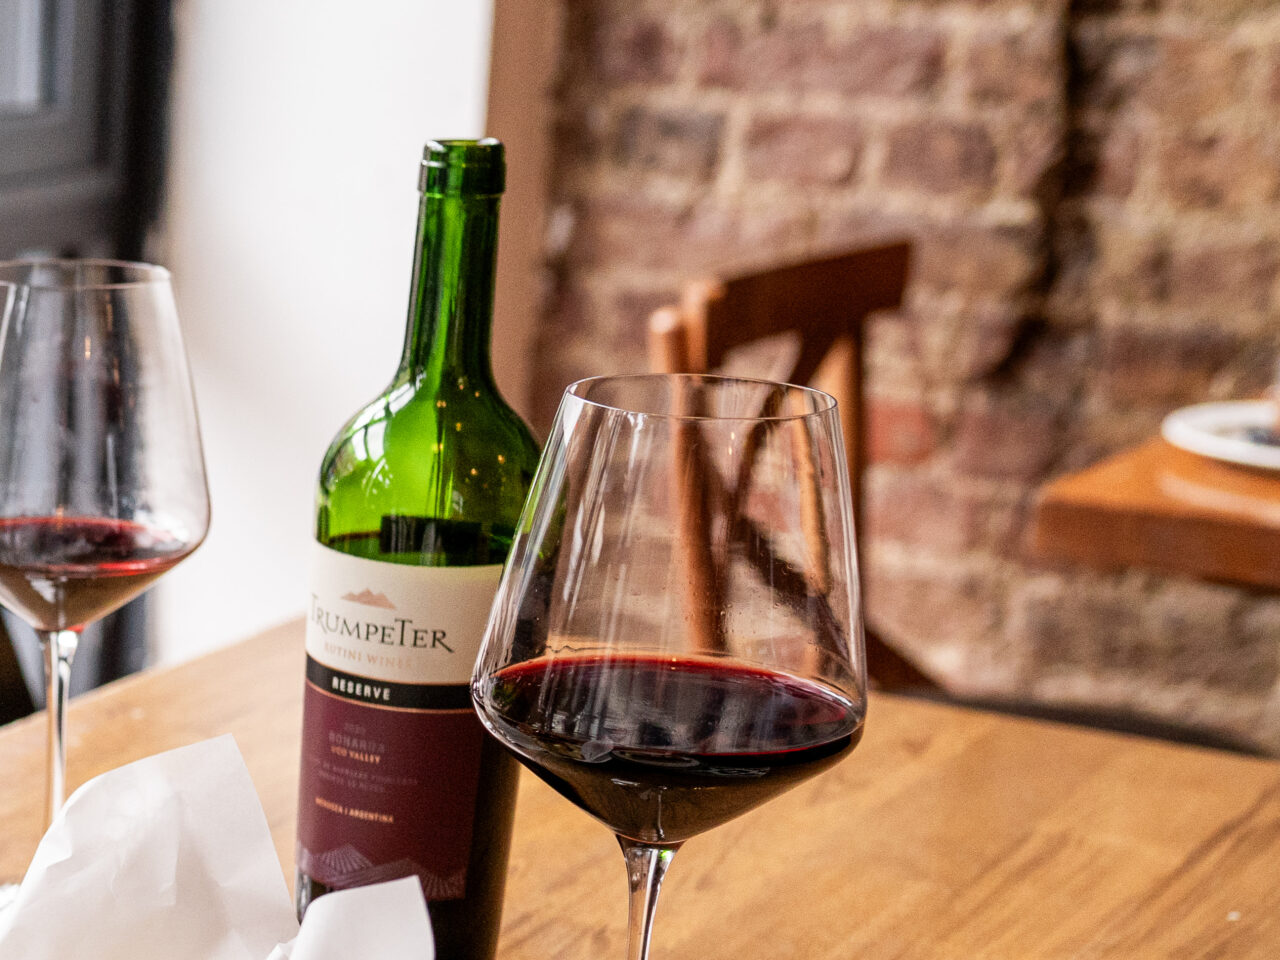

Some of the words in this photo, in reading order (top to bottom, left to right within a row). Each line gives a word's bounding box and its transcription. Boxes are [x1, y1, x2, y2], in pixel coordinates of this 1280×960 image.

[331, 676, 391, 701] RESERVE
[349, 749, 381, 765] VALLEY
[349, 808, 394, 823] ARGENTINA
